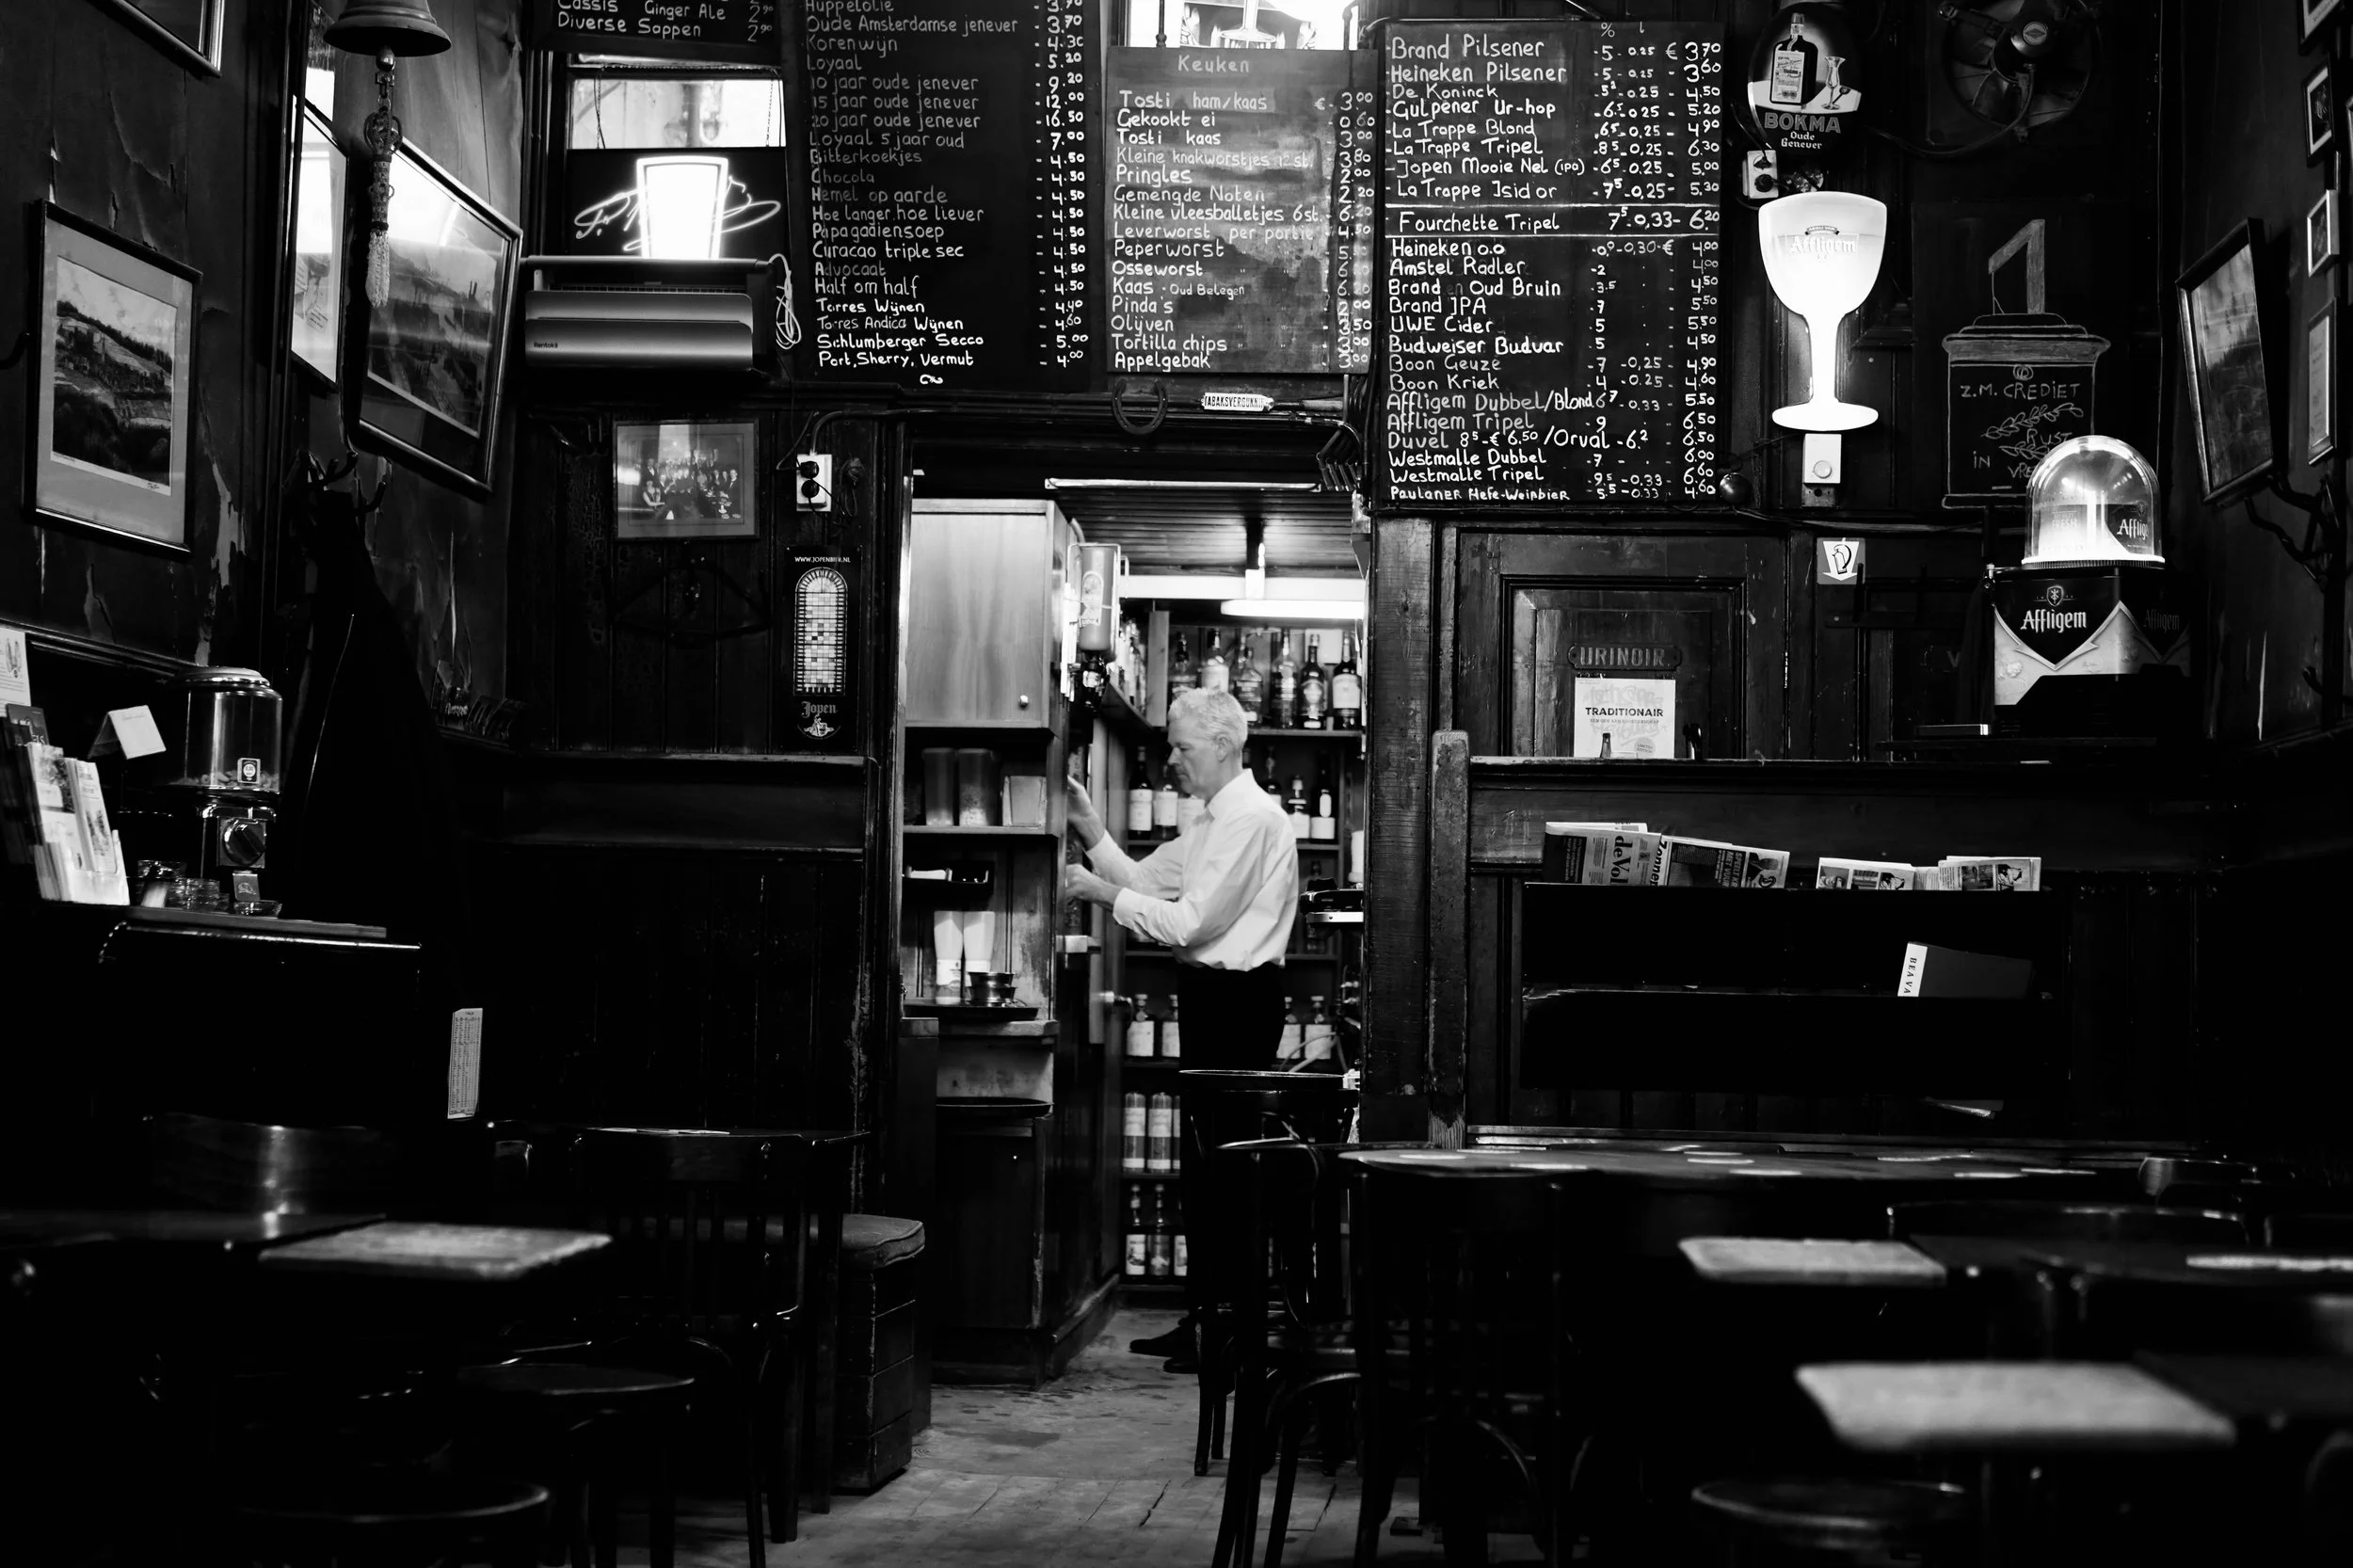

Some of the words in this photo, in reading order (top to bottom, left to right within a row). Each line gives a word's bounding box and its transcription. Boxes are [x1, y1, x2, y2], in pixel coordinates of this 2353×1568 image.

[645, 0, 690, 20] Ginger
[699, 5, 726, 20] Ale
[558, 11, 627, 32] Diverse
[807, 15, 852, 32] Oude
[858, 15, 957, 32] Amsterdamse
[962, 15, 1018, 37] jenever
[807, 34, 897, 57] Korenwijn
[1391, 34, 1450, 60] Brand
[1463, 34, 1545, 57] Pilsener
[807, 55, 862, 74] Loyaal
[1177, 55, 1249, 73] Keuken
[1391, 65, 1474, 83] Heineken
[1486, 62, 1567, 83] Pilsener
[832, 75, 867, 95] jaar
[872, 72, 910, 89] oude
[917, 73, 979, 95] jenever
[1392, 84, 1417, 99] De
[1426, 83, 1499, 99] Koninck
[813, 96, 827, 108] 15
[832, 95, 868, 113] jaar
[873, 91, 909, 108] oude
[917, 92, 979, 114] jenever
[1119, 90, 1170, 108] Tosti
[1193, 91, 1268, 110] ham/kaas
[1392, 100, 1480, 117] Gulpener
[1495, 100, 1556, 120] Ur-hop
[832, 113, 868, 132] jaar
[873, 112, 911, 128] oude
[918, 112, 981, 132] jenever
[1117, 108, 1192, 127] Gekookt
[1201, 111, 1216, 127] ei
[1764, 112, 1841, 134] BOKMA
[1116, 128, 1162, 145] Tosti
[1186, 129, 1221, 145] kaas
[1392, 122, 1413, 138] La
[1486, 119, 1535, 135] Blond
[1790, 131, 1816, 141] Oude
[809, 129, 873, 152] Loyaal
[881, 134, 890, 145] 5
[894, 133, 930, 150] jaar
[936, 132, 965, 149] oud
[1392, 141, 1414, 156] La
[1416, 138, 1470, 162] Trappe
[1481, 137, 1544, 161] Tripel
[809, 149, 922, 167] Bitterkoekjes
[1116, 147, 1166, 164] Kleine
[1173, 148, 1270, 170] knakworstjes
[1396, 159, 1452, 178] Jopen
[1462, 157, 1514, 174] Mooie
[1520, 159, 1549, 175] Nel
[1116, 164, 1193, 188] Pringles
[870, 190, 888, 204] op
[894, 184, 949, 204] aarde
[1113, 184, 1201, 208] Gemengde
[1209, 185, 1265, 201] Noten
[1398, 180, 1417, 198] La
[812, 205, 840, 220] Hoe
[845, 205, 890, 227] langer
[897, 203, 928, 222] hoe
[935, 205, 984, 222] liever
[1113, 203, 1165, 221] Kleine
[1171, 203, 1285, 226] vleesballetjes
[1399, 212, 1499, 234] Fourchette
[1505, 213, 1561, 233] Tripel
[1113, 222, 1210, 238] Leverworst
[1228, 229, 1255, 244] per
[1265, 224, 1314, 244] portie
[812, 240, 876, 259] Curacao
[886, 240, 932, 260] triple
[936, 245, 965, 257] sec
[1113, 239, 1224, 257] Peperworst
[1392, 237, 1471, 257] Heineken
[1790, 235, 1857, 254] Affligem
[815, 263, 887, 277] Advocaat
[1112, 261, 1203, 276] Osseworst
[1389, 257, 1454, 277] Amstel
[1463, 256, 1526, 276] Radler
[815, 277, 847, 296] Half
[855, 280, 877, 294] om
[884, 275, 920, 298] half
[1112, 277, 1154, 295] Kaas
[1170, 284, 1193, 296] Oud
[1197, 284, 1245, 300] Belegen
[1388, 278, 1441, 297] Brand
[1469, 280, 1506, 296] Oud
[1513, 279, 1561, 297] Bruin
[816, 297, 867, 312] Torres
[874, 298, 925, 315] Wijnen
[1112, 295, 1174, 313] Pinda's
[1389, 296, 1442, 313] Brand
[865, 316, 906, 329] Andica
[914, 317, 964, 333] Wijnen
[1111, 314, 1174, 337] Olijven
[1391, 315, 1435, 333] UWE
[1444, 315, 1495, 334] Cider
[817, 334, 926, 352] Schlumberger
[935, 334, 984, 346] Secco
[1111, 333, 1176, 351] Tortilla
[1182, 333, 1227, 355] chips
[1389, 334, 1485, 354] Budweiser
[1495, 336, 1564, 354] Budvar
[920, 350, 974, 367] Vermut
[1114, 351, 1210, 372] Appelgebak
[1389, 355, 1434, 371] Boon
[1444, 356, 1501, 371] Geuze
[1389, 375, 1439, 392] Boon
[1447, 375, 1499, 391] Kriek
[2003, 380, 2080, 400] CREDIET
[1385, 393, 1466, 414] Affligem
[1387, 415, 1465, 434] Affligem
[1473, 413, 1534, 435] Tripel
[1387, 432, 1449, 450] Duvel
[1388, 450, 1481, 468] Westmalle
[1487, 447, 1547, 465] Dubbel
[1390, 468, 1485, 484] Westmalle
[1490, 468, 1545, 482] Tripel
[1390, 488, 1462, 501] Paulaner
[2020, 609, 2087, 633] Affligem
[801, 700, 838, 718] Jopen
[1585, 708, 1664, 716] TRADITIONAIR
